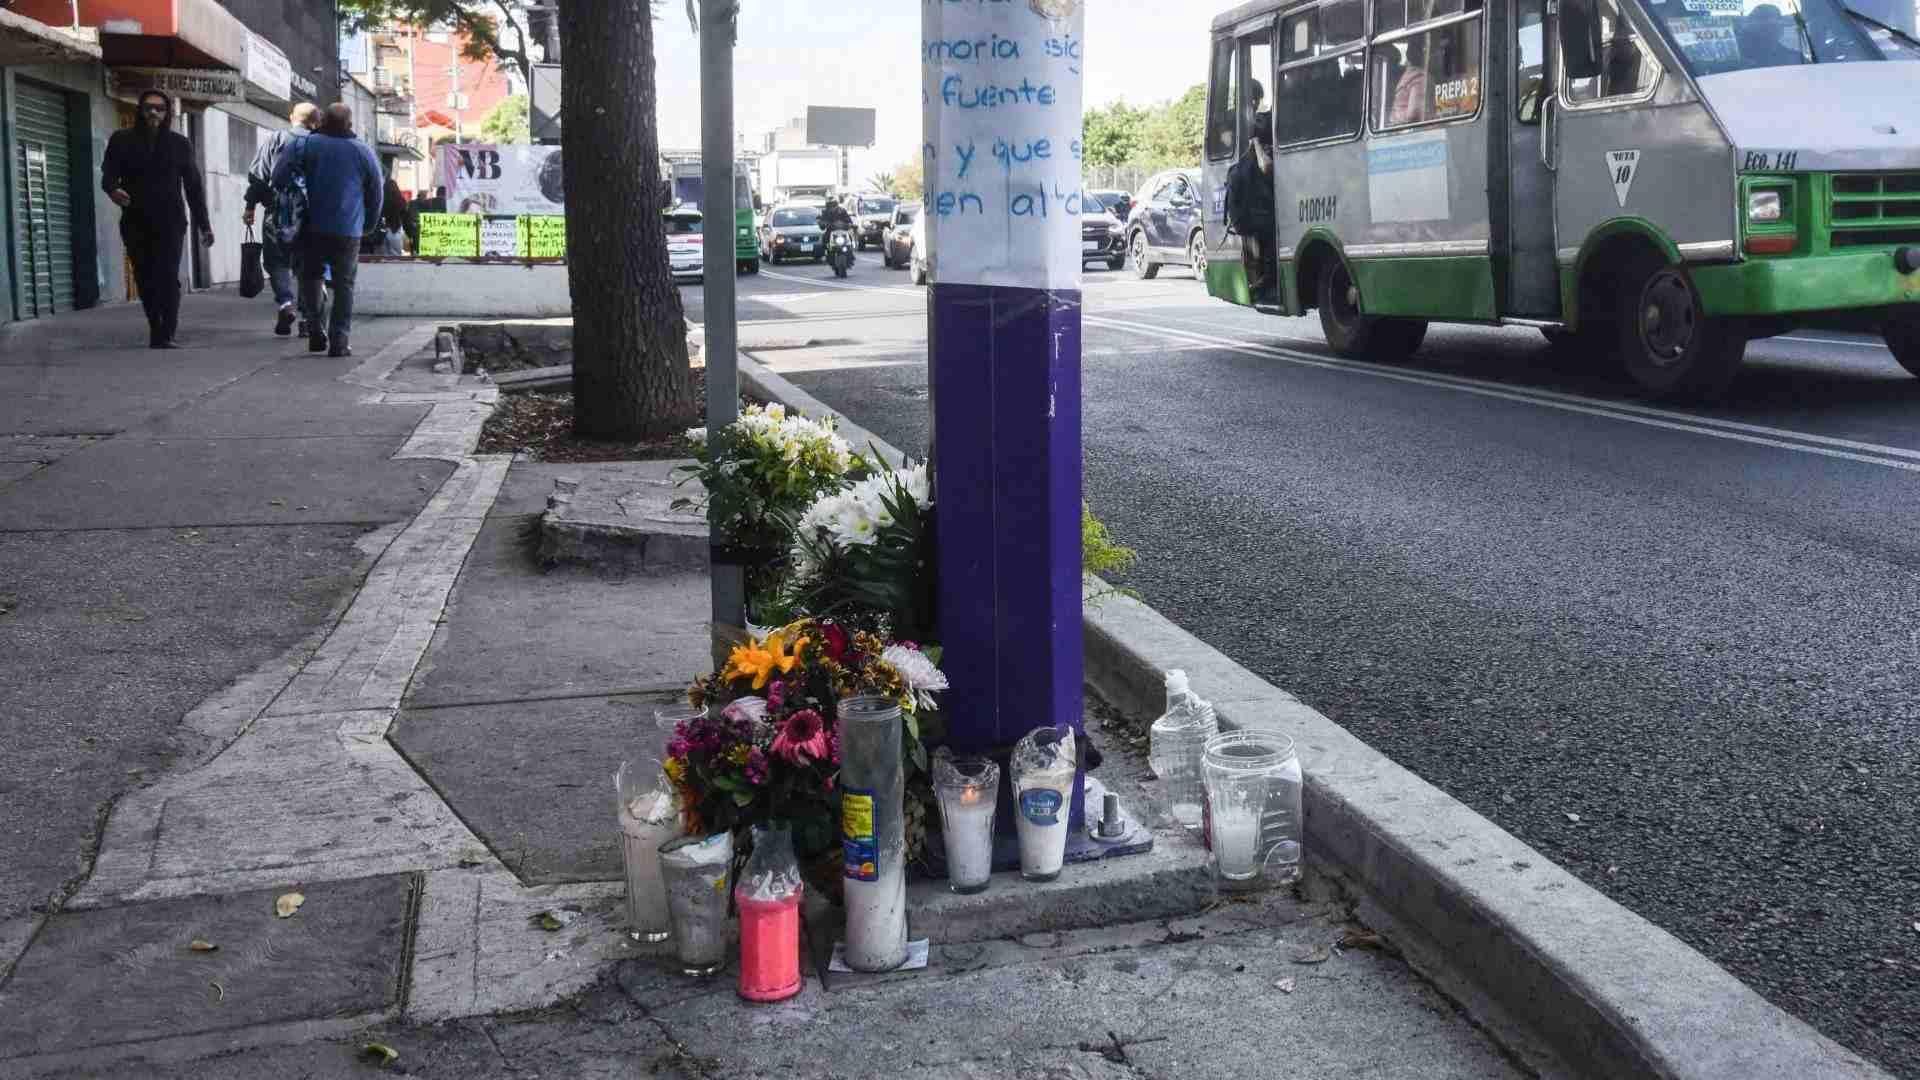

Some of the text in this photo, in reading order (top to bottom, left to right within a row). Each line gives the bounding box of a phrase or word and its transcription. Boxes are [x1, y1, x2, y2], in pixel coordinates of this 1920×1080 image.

[1435, 77, 1478, 100] PREPA 2
[956, 137, 976, 178] y
[992, 137, 1052, 171] que
[1744, 150, 1799, 171] Eco. 141
[1615, 164, 1631, 184] 10
[1299, 195, 1337, 222] 0100141
